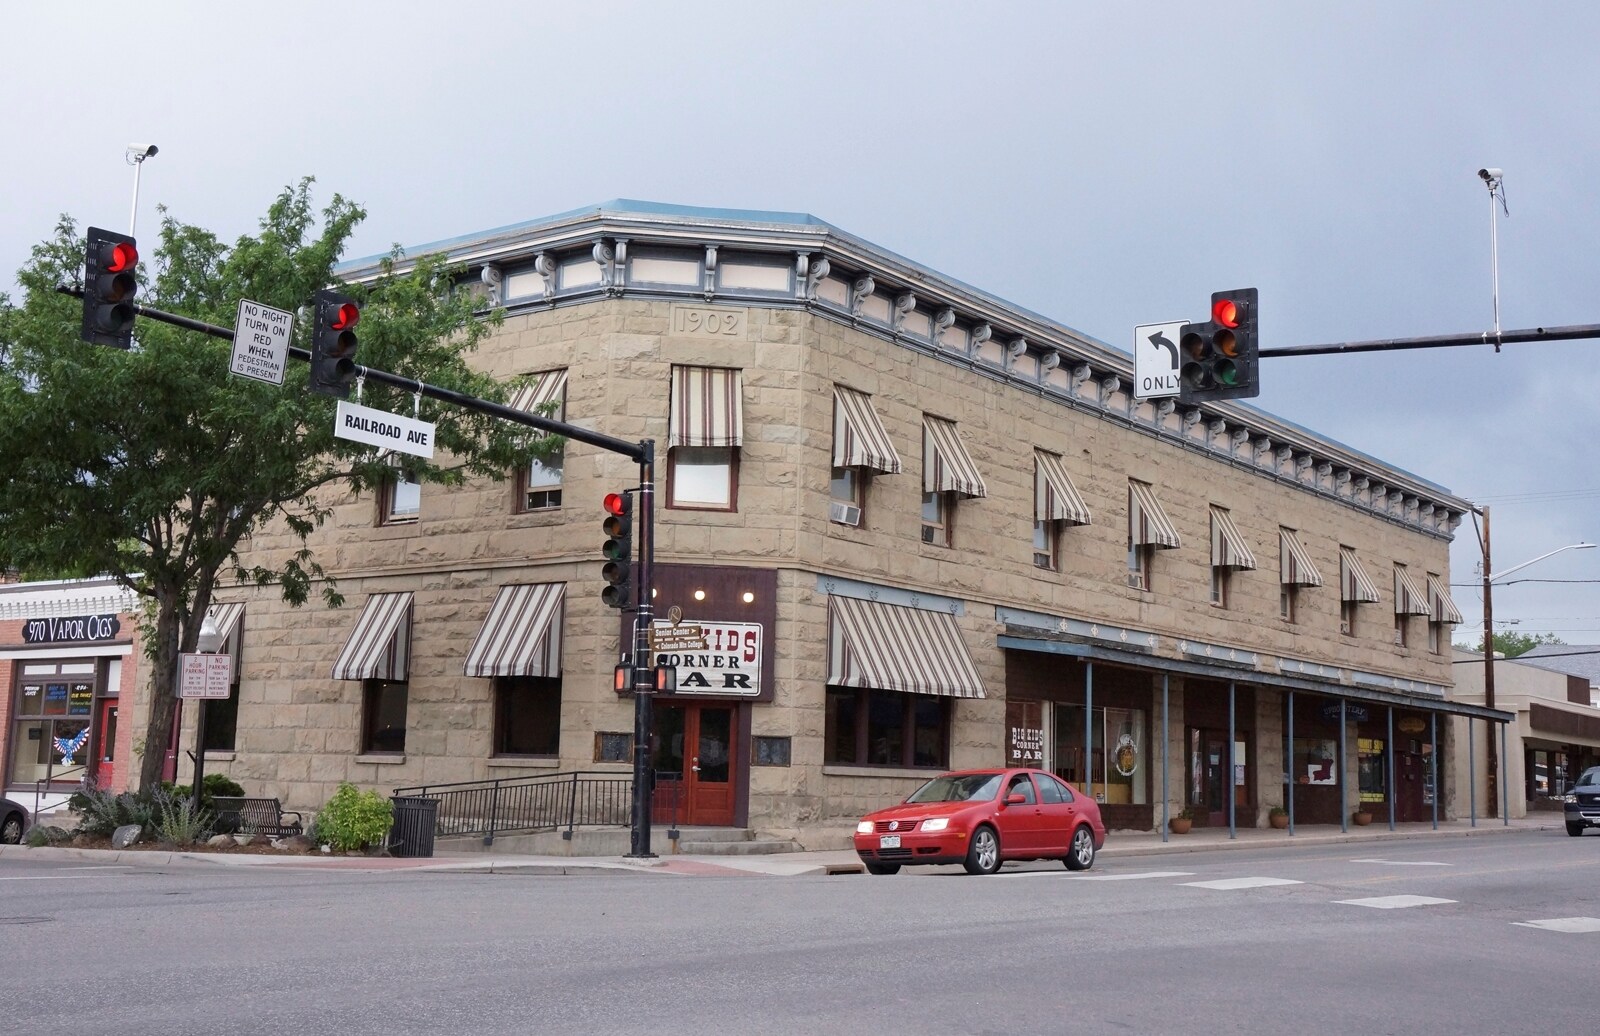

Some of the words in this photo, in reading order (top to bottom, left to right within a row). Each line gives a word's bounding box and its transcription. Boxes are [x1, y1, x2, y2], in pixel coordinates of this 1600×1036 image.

[245, 305, 258, 317] NO
[262, 310, 288, 325] RIGHT
[679, 310, 739, 336] 1902
[245, 317, 269, 333] TURN
[272, 325, 286, 337] ON
[253, 333, 272, 346] RED
[248, 344, 274, 360] WHEN
[237, 353, 280, 371] PEDESTRIAN
[236, 363, 244, 372] IS
[246, 366, 277, 380] PRESENT
[1143, 374, 1181, 391] ONLY
[345, 414, 402, 439] RAILROAD
[406, 430, 428, 446] AVE
[29, 620, 46, 642] 970
[49, 618, 85, 641] VAPOR
[87, 615, 112, 640] CIGS
[655, 629, 672, 637] Senior
[673, 628, 690, 636] Center
[660, 642, 679, 650] Colorado
[688, 640, 703, 649] College
[679, 671, 753, 689] AR
[1012, 727, 1025, 745] BIG
[1027, 729, 1044, 746] KIDS
[1016, 741, 1040, 750] CORNER
[1012, 749, 1043, 760] BAR
